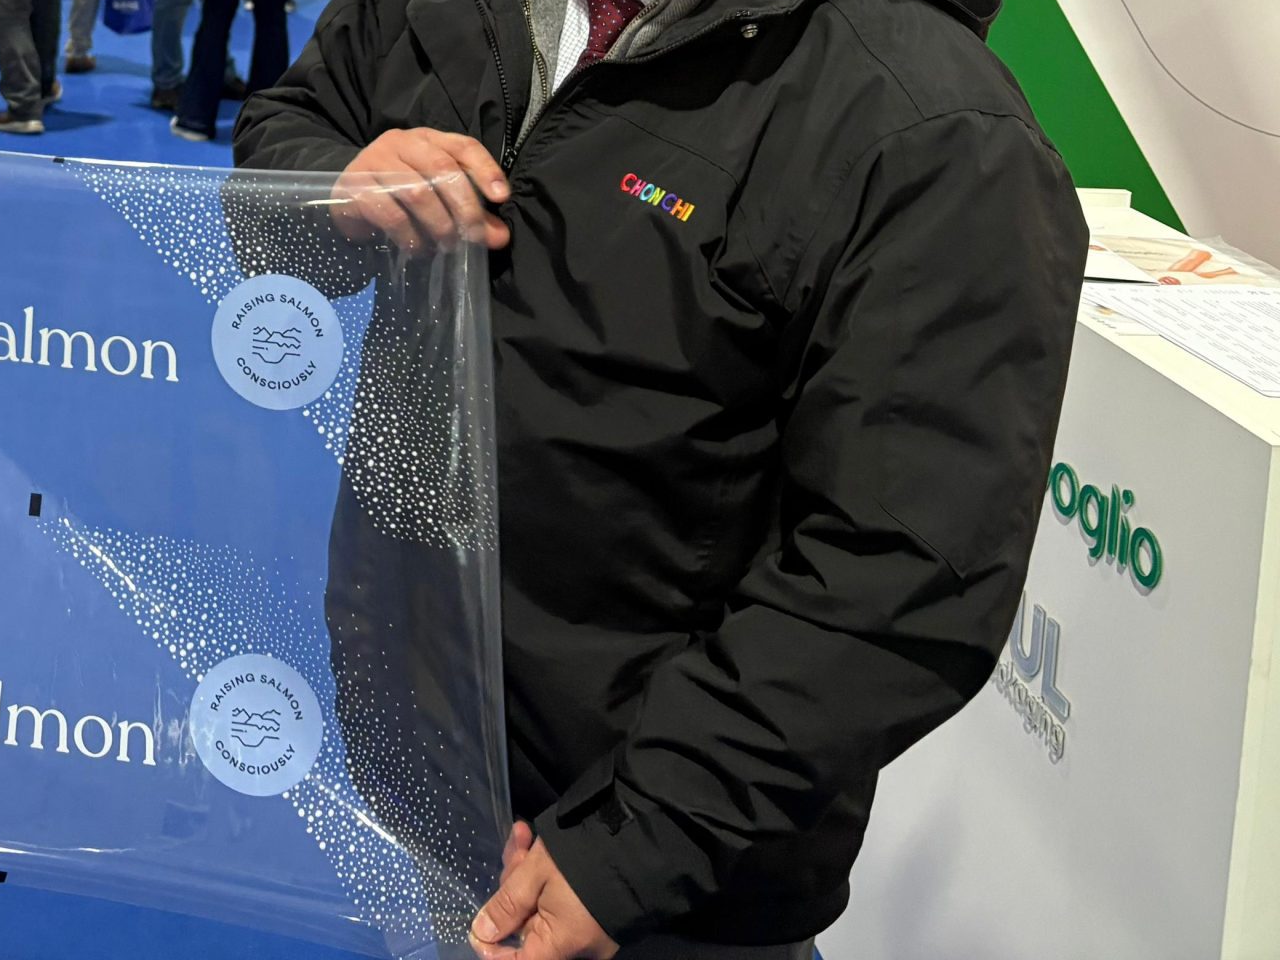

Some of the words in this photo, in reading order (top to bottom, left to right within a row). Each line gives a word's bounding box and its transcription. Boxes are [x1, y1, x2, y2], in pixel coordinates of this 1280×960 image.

[620, 172, 695, 222] CHONCHI
[232, 293, 275, 329] RAISING
[280, 294, 324, 338] SALMON
[236, 357, 317, 390] CONSCIOUSLY
[1047, 461, 1163, 590] oglio
[210, 673, 255, 712] RAISING
[260, 674, 303, 721] SALMON
[215, 740, 295, 775] CONSCIOUSLY
